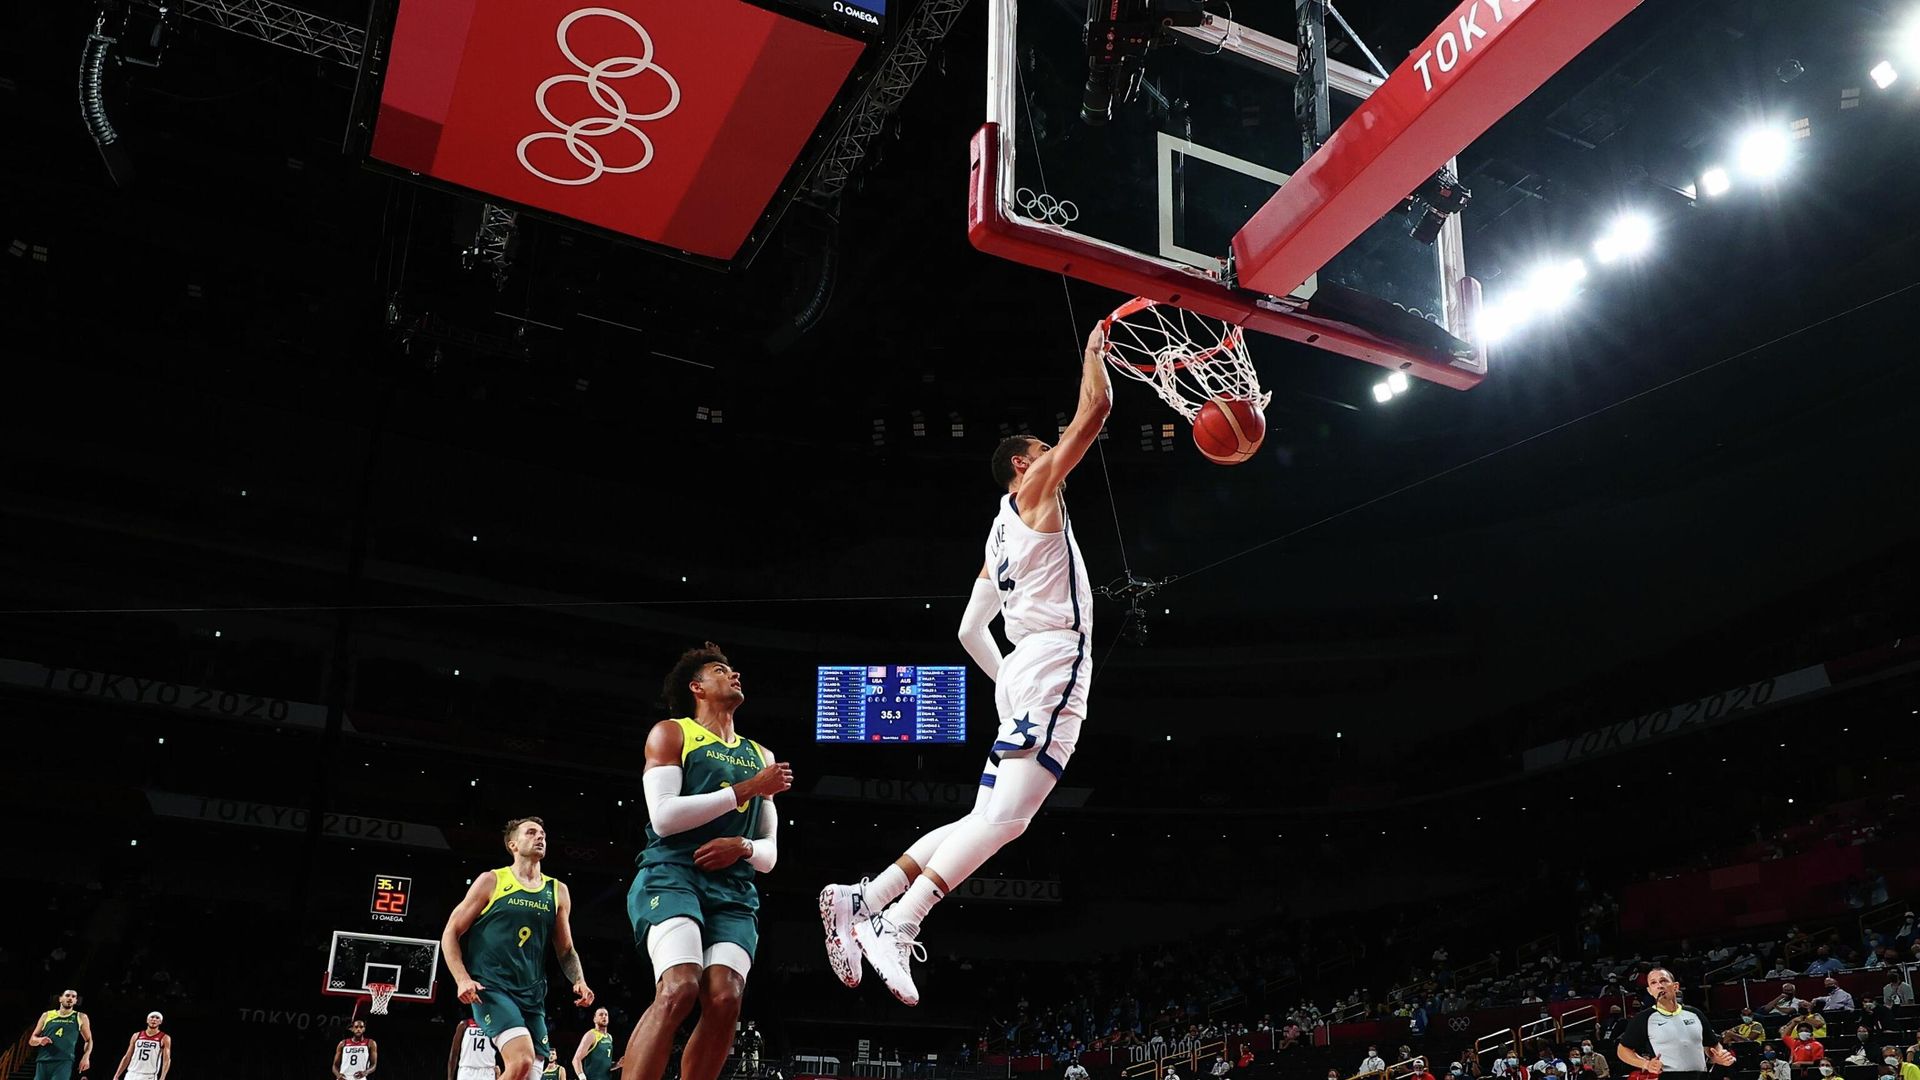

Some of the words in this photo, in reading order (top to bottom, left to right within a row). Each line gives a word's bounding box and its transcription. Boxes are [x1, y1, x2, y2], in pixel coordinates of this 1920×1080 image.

[845, 6, 879, 26] OMEGA
[44, 667, 180, 704] TOKYO
[191, 688, 289, 721] 2020
[871, 686, 884, 695] 70
[880, 710, 901, 719] 35.3
[1563, 708, 1672, 760] TOKYO
[1679, 678, 1775, 728] 2020
[706, 749, 757, 769] AUSTRALIA
[199, 796, 311, 830] TOKYO
[322, 814, 404, 841] 2020
[993, 879, 1063, 899] 2020
[376, 891, 405, 912] 22
[507, 898, 549, 912] AUSTRALIA
[379, 914, 404, 922] OMEGA
[518, 926, 531, 947] 9
[55, 1027, 64, 1038] 4
[137, 1041, 157, 1049] USA
[473, 1037, 486, 1052] 14
[1128, 1041, 1168, 1063] TOKYO
[139, 1049, 151, 1061] 15
[349, 1054, 358, 1066] 8
